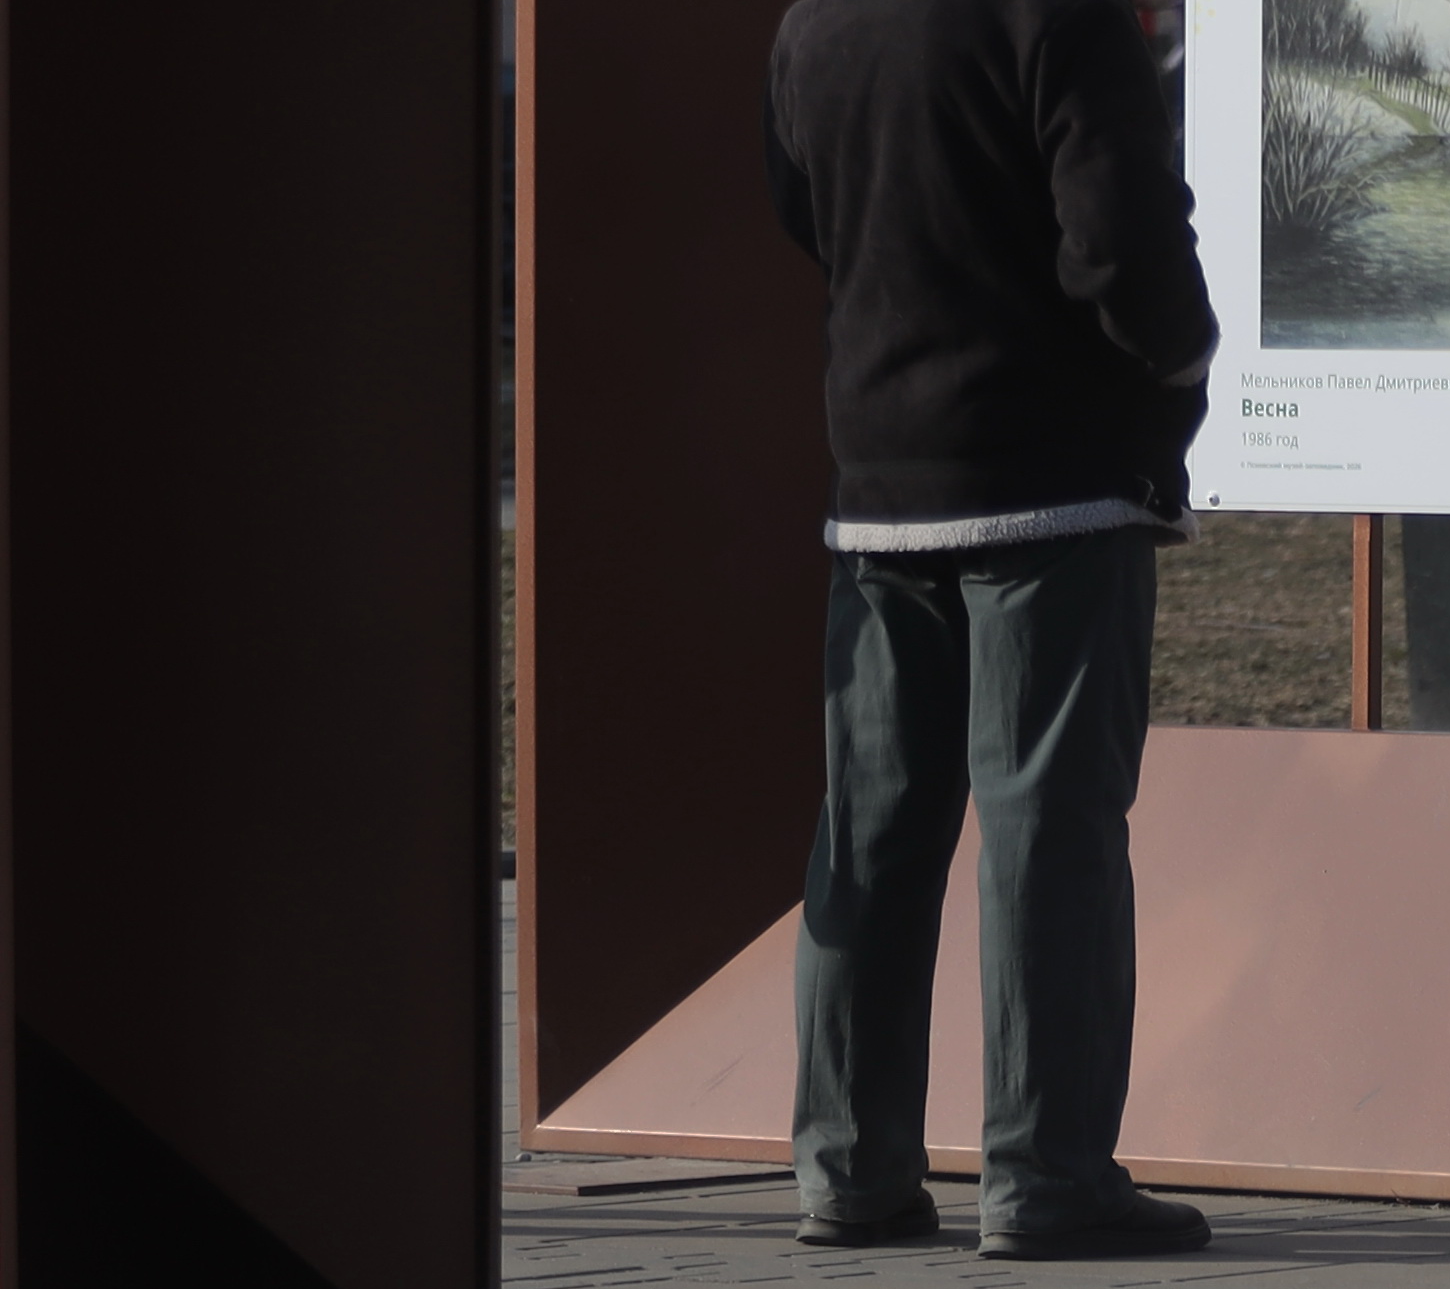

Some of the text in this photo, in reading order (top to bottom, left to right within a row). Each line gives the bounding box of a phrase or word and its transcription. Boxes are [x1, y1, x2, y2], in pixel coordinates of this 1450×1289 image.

[1241, 373, 1323, 389] Мельников
[1327, 374, 1371, 389] Павел
[1241, 398, 1299, 418] Весна
[1242, 432, 1299, 450] 1986 год
